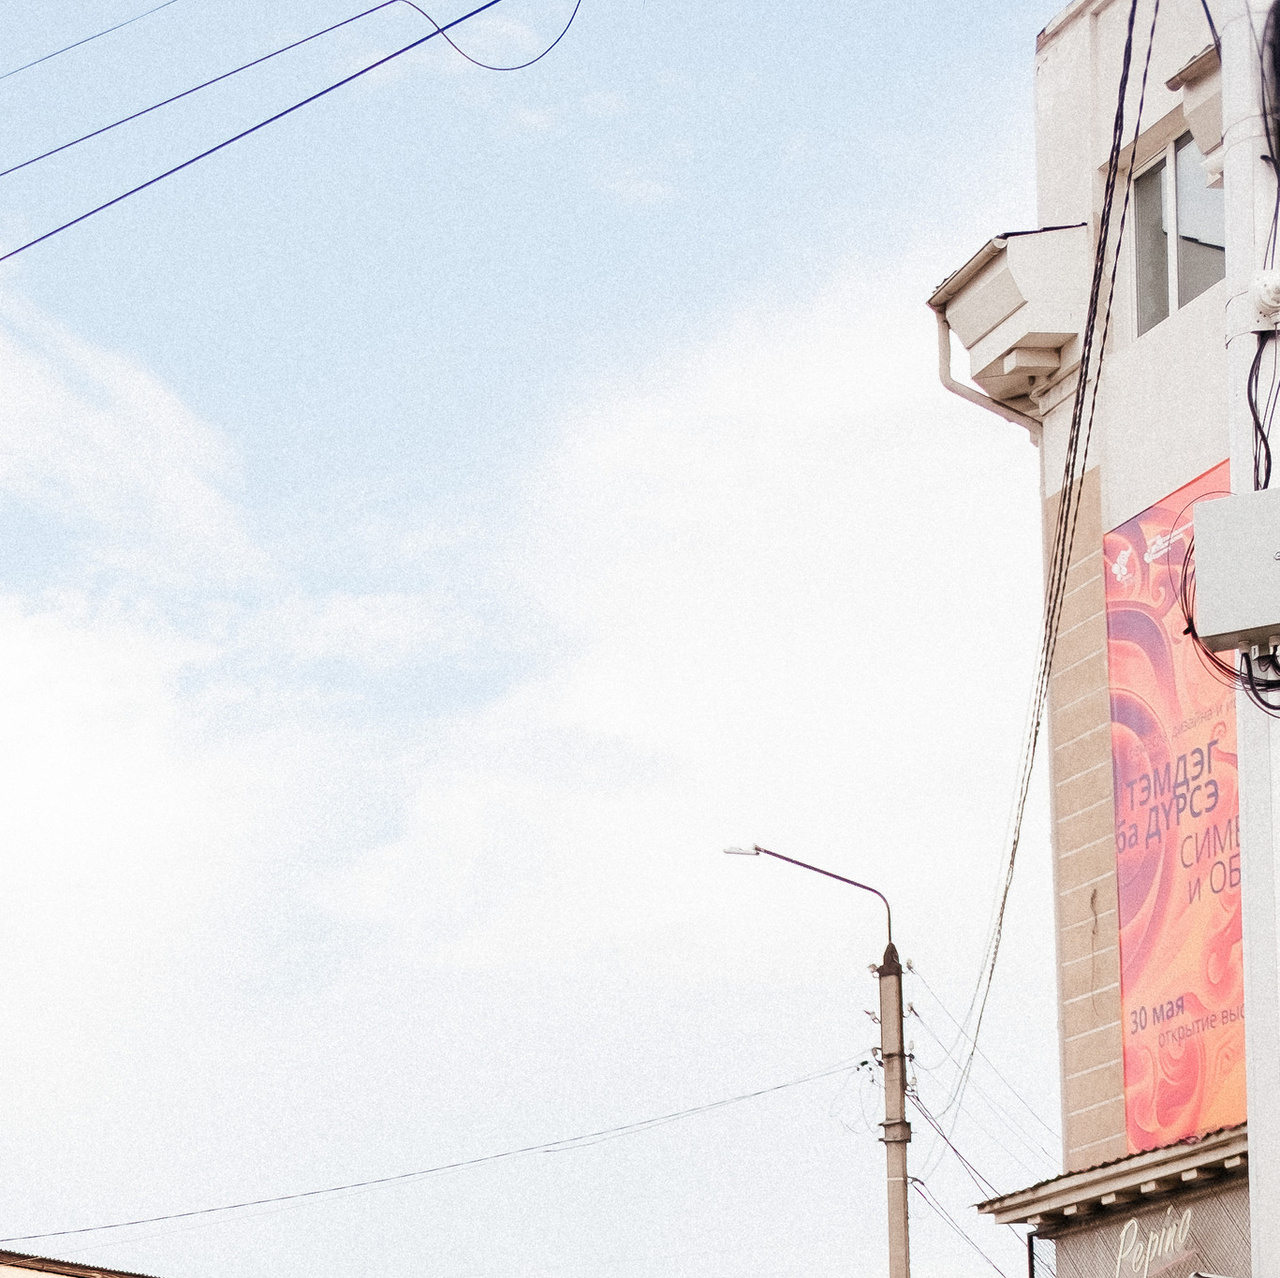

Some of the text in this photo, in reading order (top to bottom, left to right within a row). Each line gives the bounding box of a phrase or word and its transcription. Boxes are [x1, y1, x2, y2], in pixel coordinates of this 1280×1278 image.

[1126, 739, 1219, 811] ТЭМДЭГ
[1130, 996, 1185, 1035] 30 мая
[1158, 1013, 1217, 1048] открытие
